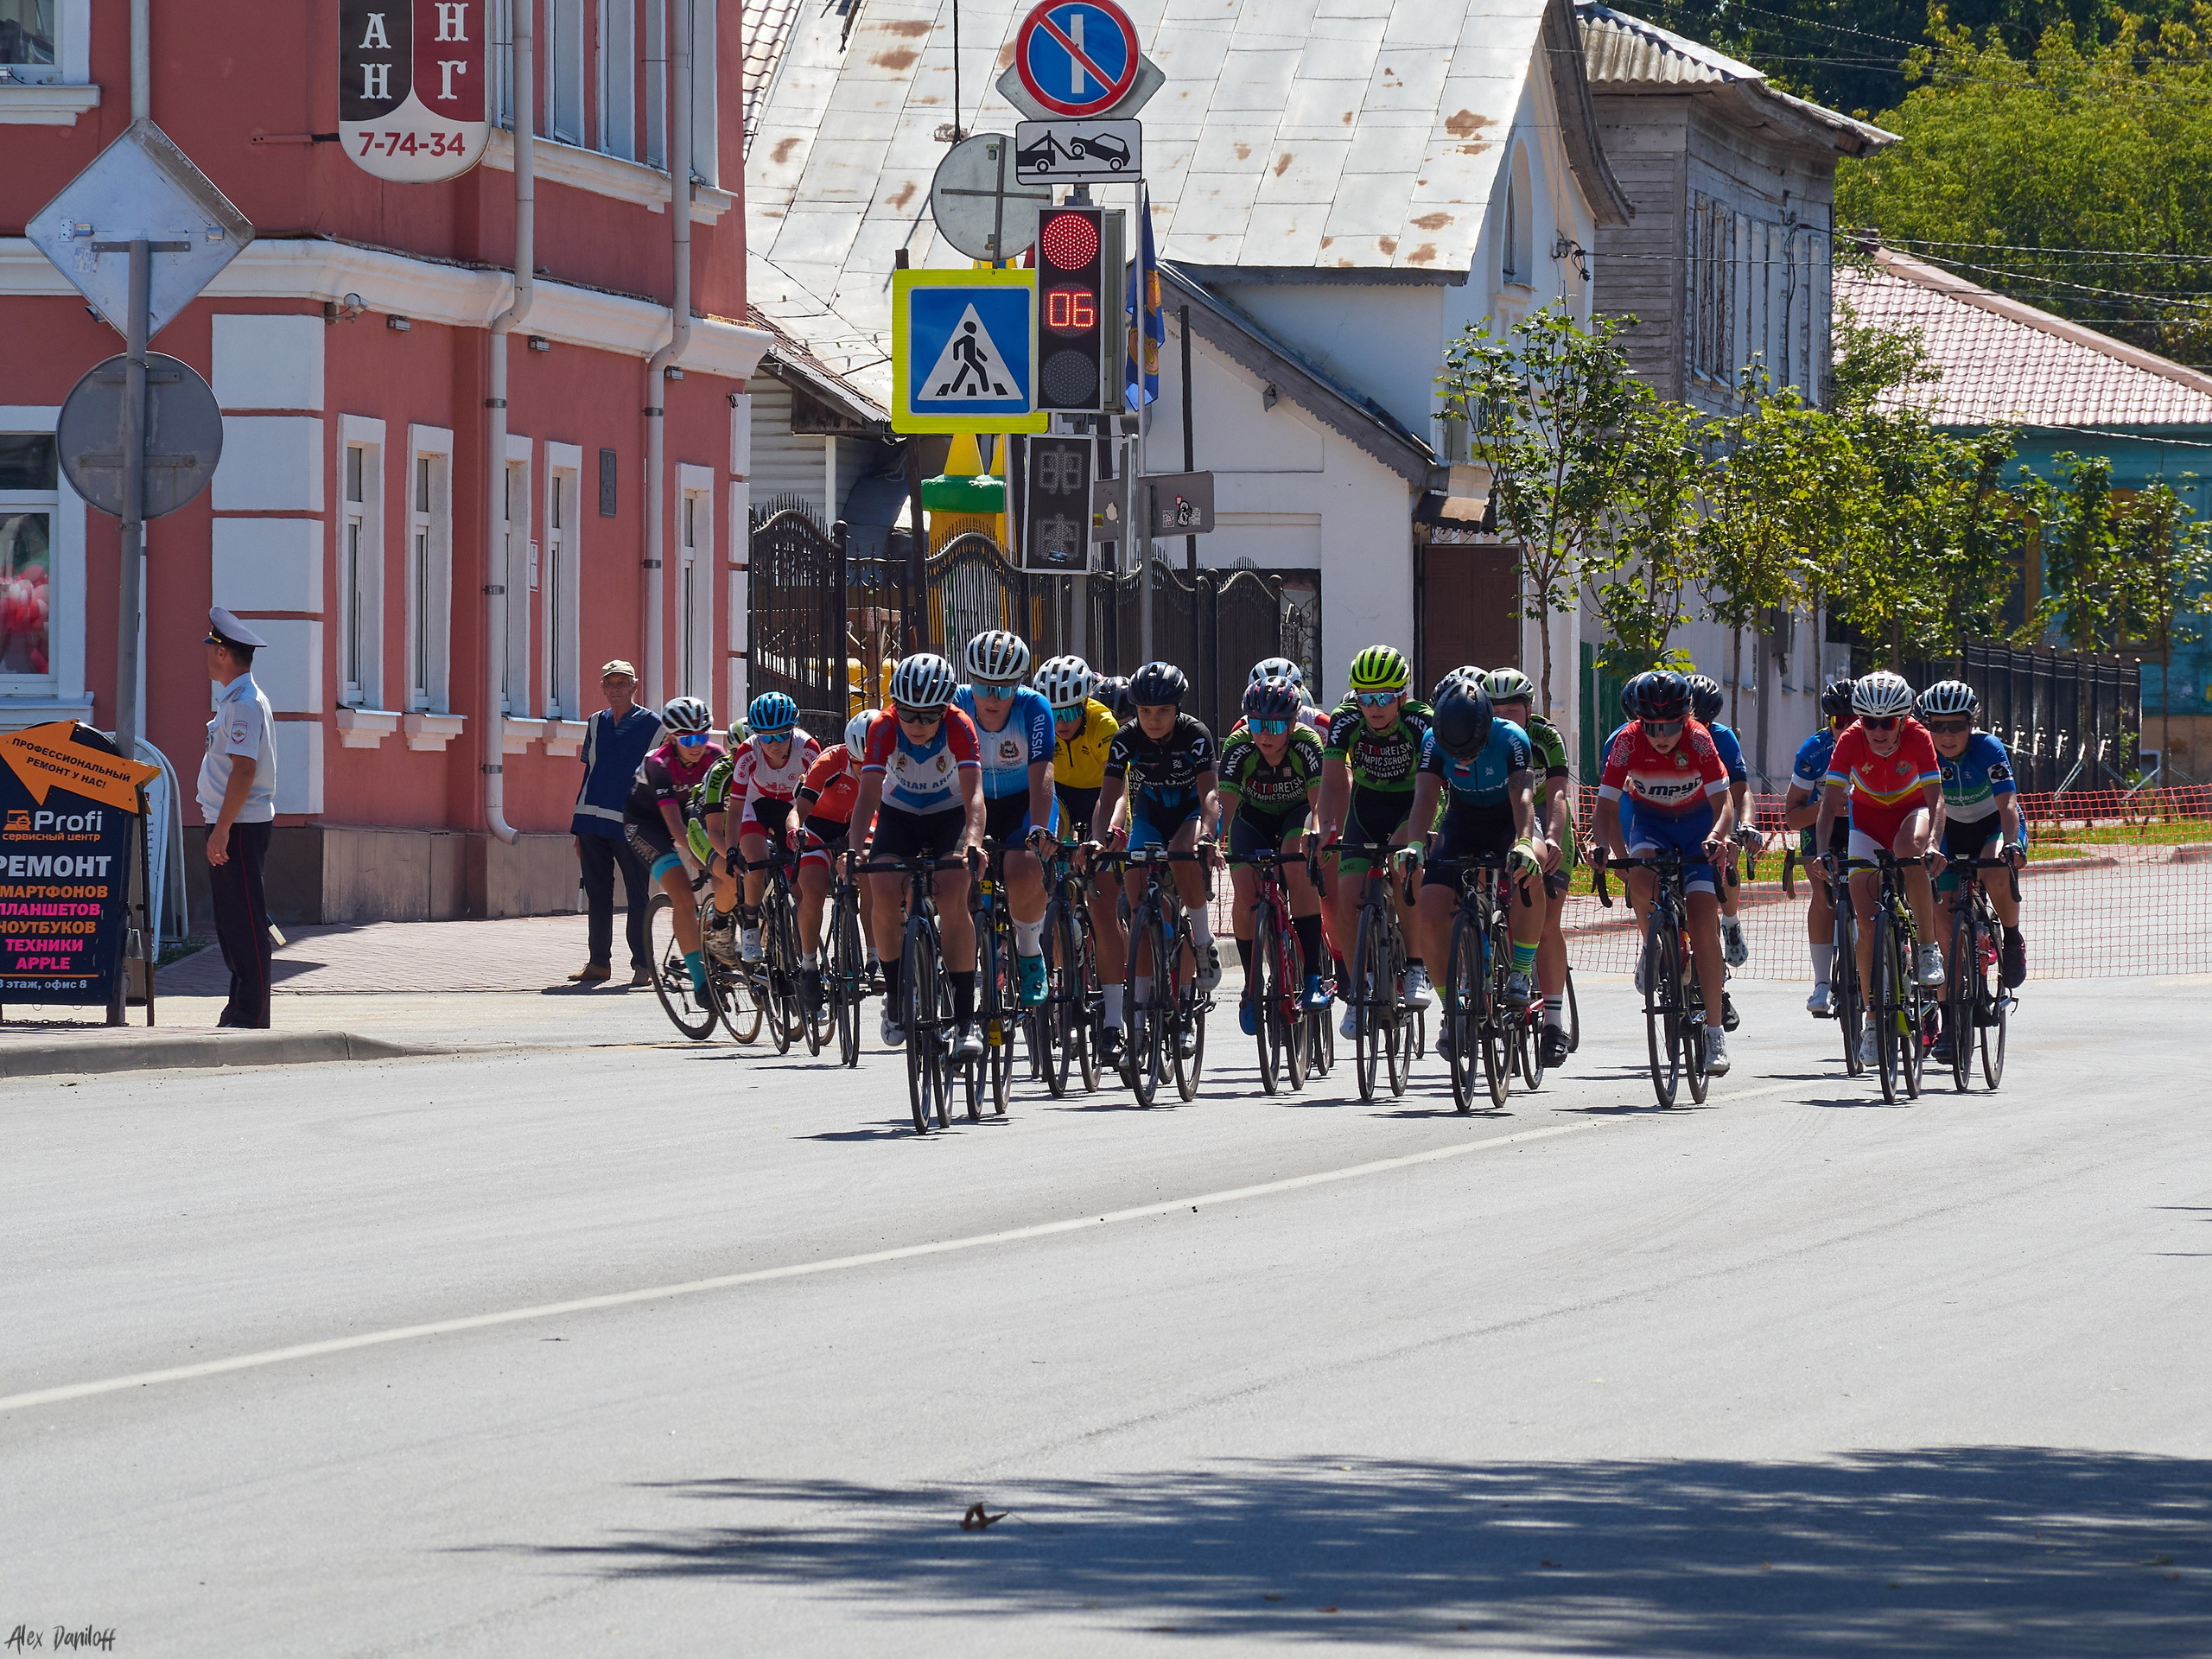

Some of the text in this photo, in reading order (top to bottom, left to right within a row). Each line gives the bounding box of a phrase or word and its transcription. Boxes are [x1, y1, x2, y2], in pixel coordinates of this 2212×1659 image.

[359, 132, 466, 156] 7-74-34
[1049, 292, 1095, 328] 06
[1031, 714, 1045, 760] RUSSIA
[12, 738, 130, 783] ПРОФЕССИОНАЛЬНЫЙ
[1224, 744, 1252, 776] MICHE
[1294, 742, 1319, 772] MICHE
[1383, 753, 1412, 766] SCHOOL
[26, 756, 71, 777] РЕМОНТ
[81, 774, 107, 789] НАС!
[1246, 786, 1277, 801] OLYMPIC
[1277, 787, 1305, 801] SCHOOL
[34, 810, 103, 831] Profi
[2, 832, 100, 842] сервисный центр
[5, 939, 84, 952] ТЕХНИКИ
[16, 957, 71, 969] APPLE
[6, 981, 41, 991] этаж,
[45, 979, 77, 991] офис
[79, 979, 87, 988] 8
